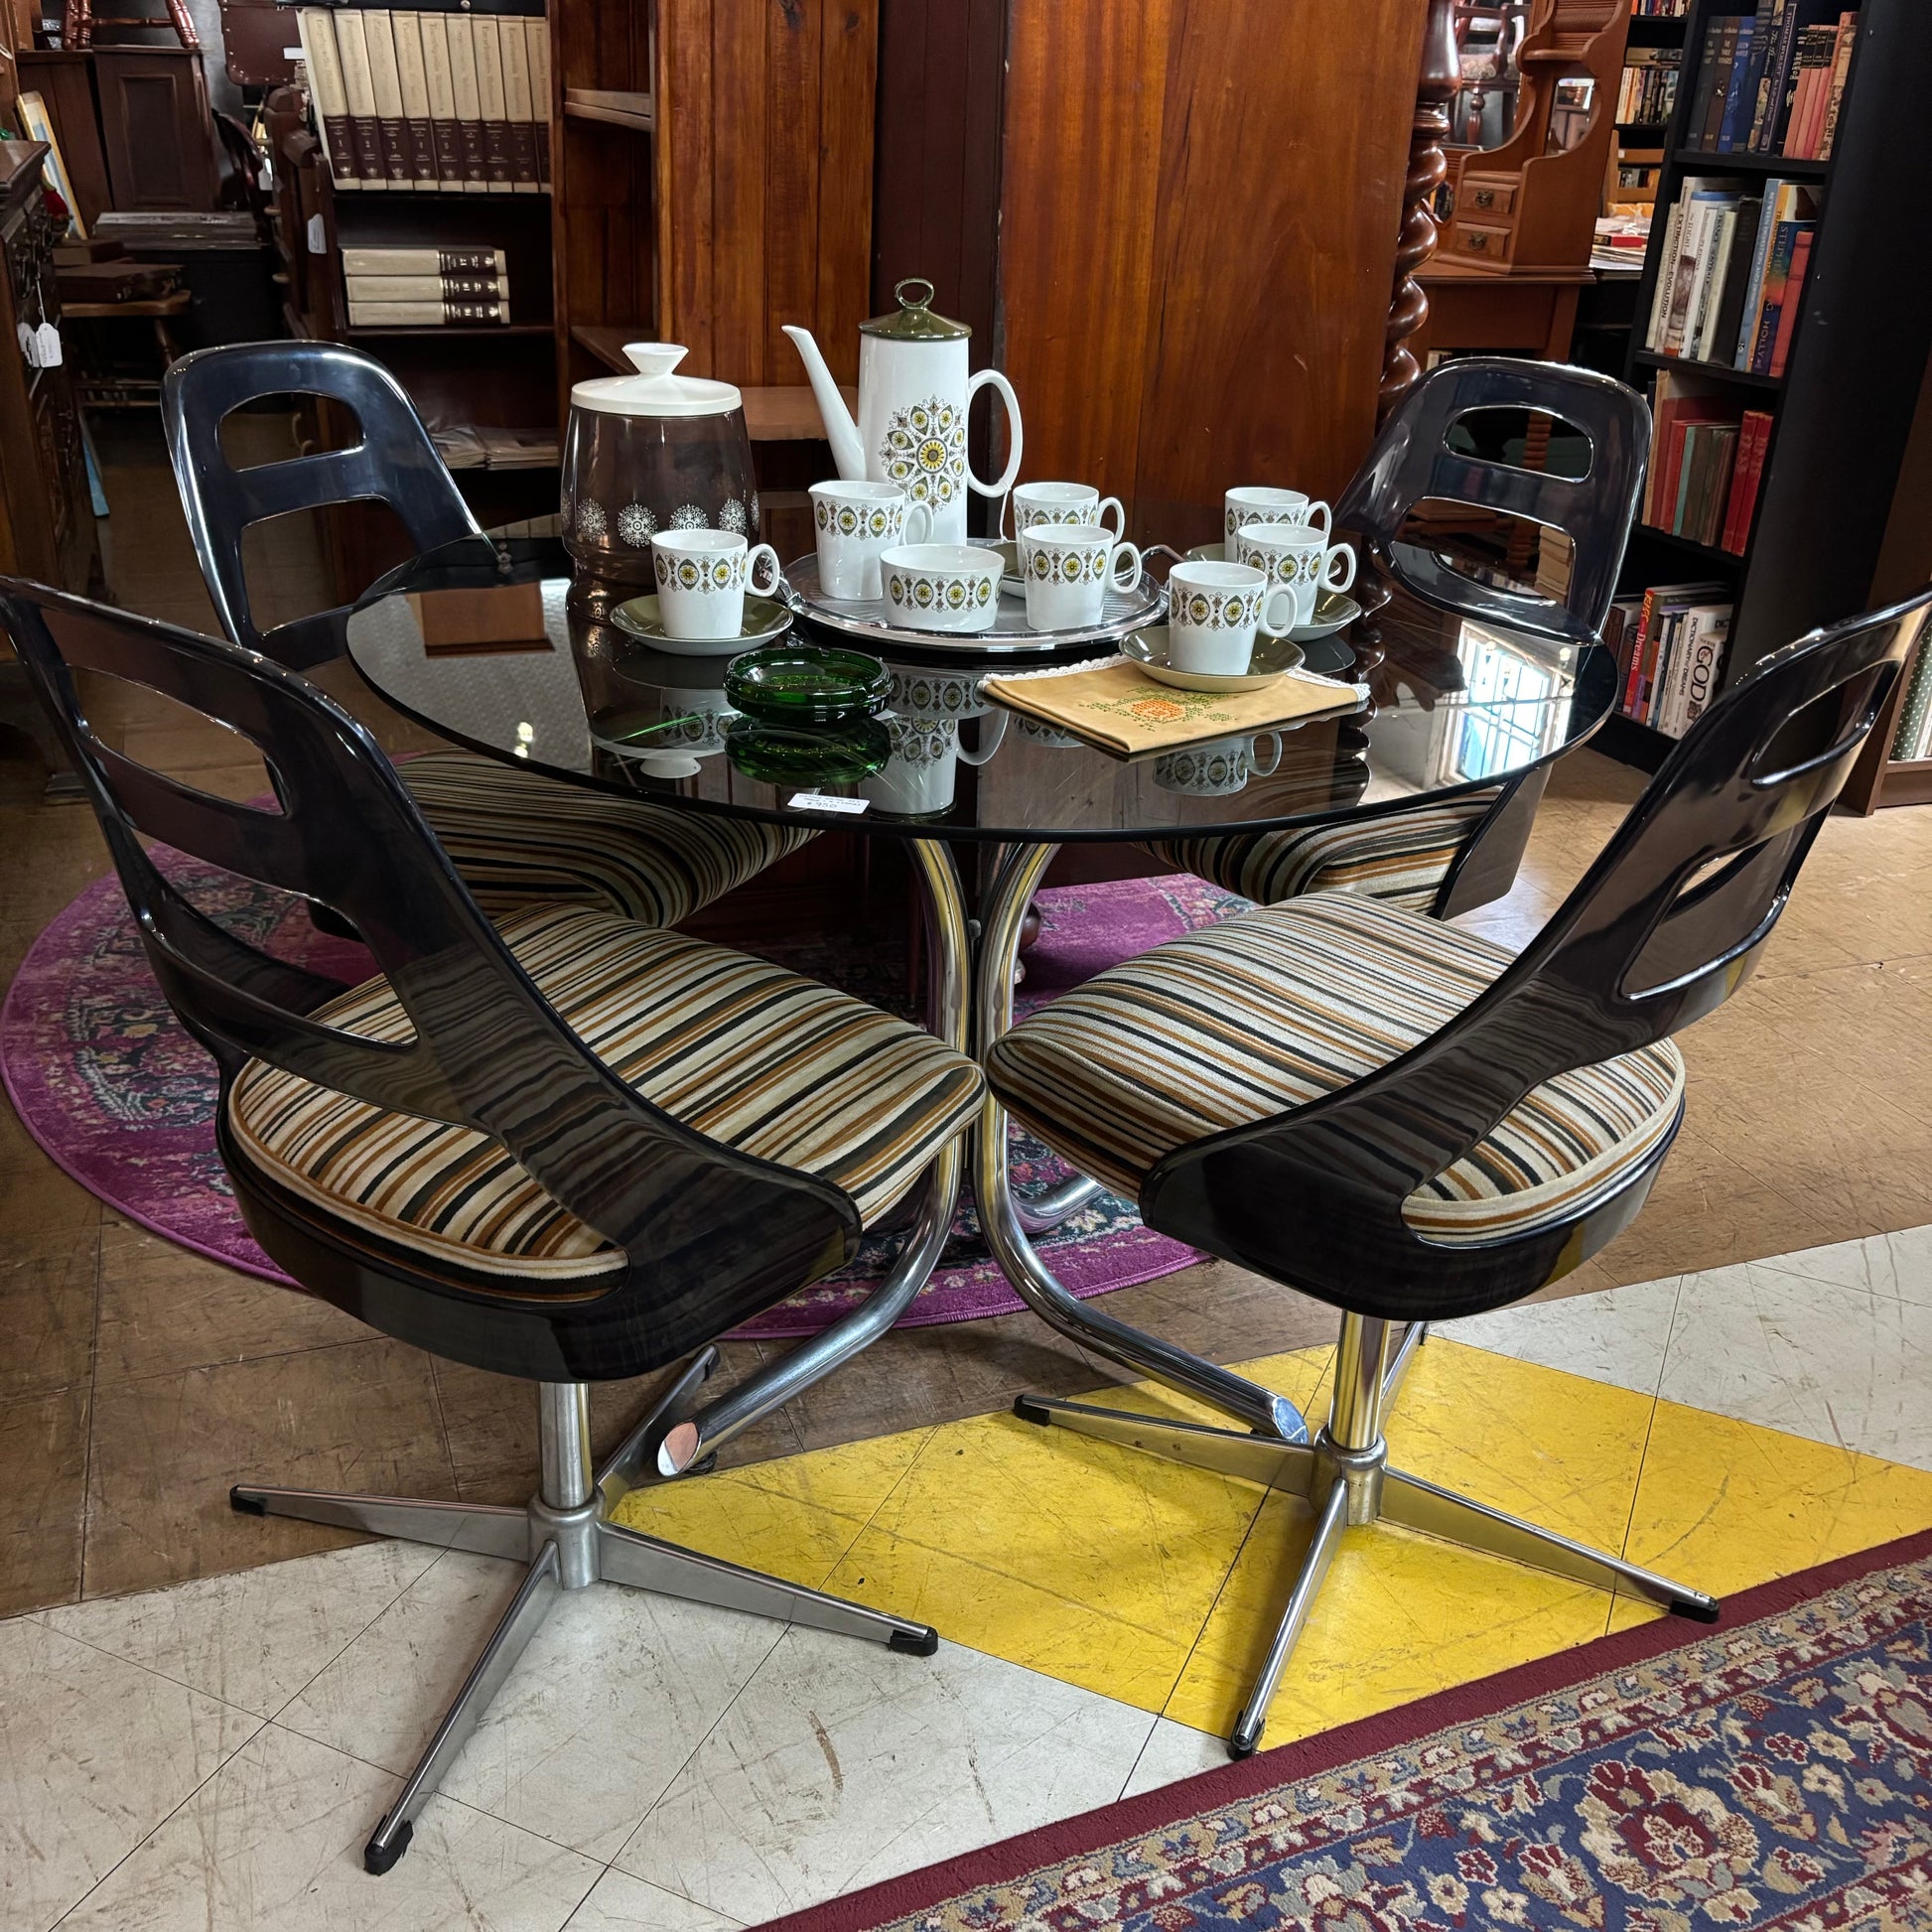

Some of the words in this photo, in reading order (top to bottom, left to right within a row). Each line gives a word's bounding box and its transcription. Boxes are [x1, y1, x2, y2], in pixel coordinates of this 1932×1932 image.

[1671, 214, 1684, 265] EXTINCTION
[1660, 271, 1674, 320] EVOLUTION
[1759, 321, 1770, 359] HOLLY
[1630, 632, 1646, 671] Dreams
[1686, 617, 1699, 659] DICTIONARY
[1679, 667, 1689, 696] DREAMS
[1690, 645, 1714, 702] GOD
